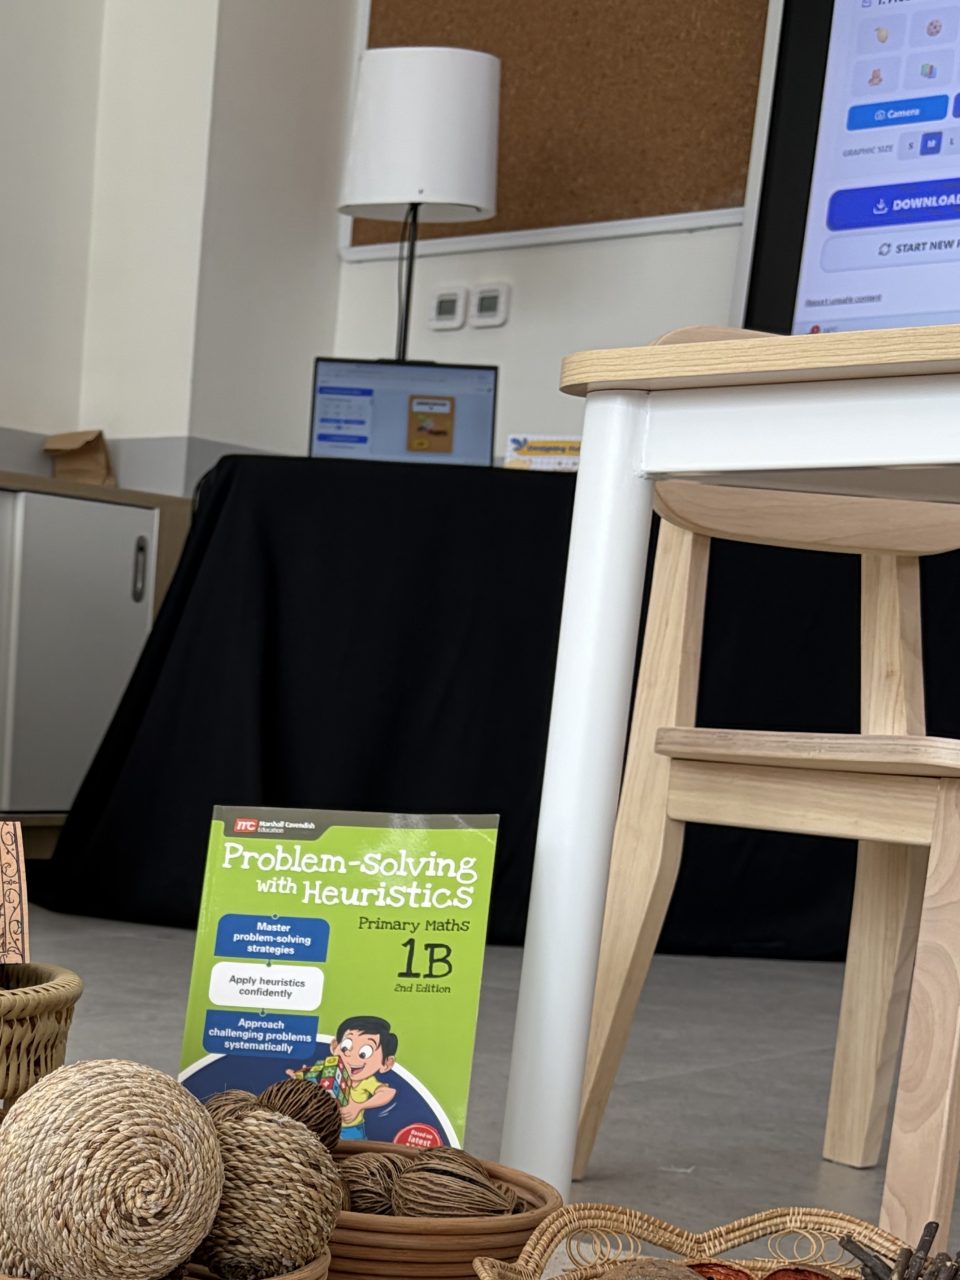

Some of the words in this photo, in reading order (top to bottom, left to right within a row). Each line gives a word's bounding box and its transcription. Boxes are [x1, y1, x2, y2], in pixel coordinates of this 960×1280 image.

[887, 108, 920, 119] Camera
[877, 144, 894, 153] SIZE
[908, 142, 915, 150] S
[927, 140, 937, 149] M
[895, 241, 928, 255] START
[929, 239, 956, 251] NEW
[285, 821, 316, 829] Cavendish
[256, 877, 298, 895] with
[302, 880, 475, 910] Heuristics
[256, 922, 291, 932] Master
[358, 916, 421, 934] Primary
[425, 918, 471, 932] Maths
[233, 932, 312, 947] problem-solving
[247, 944, 295, 956] strategies
[397, 937, 453, 979] 1B
[229, 975, 257, 986] Apply
[259, 976, 306, 988] heuristics
[238, 987, 293, 1000] confidently
[394, 983, 413, 993] 2nd
[415, 983, 452, 994] Edition
[237, 1018, 285, 1030] Approach
[208, 1028, 264, 1041] challenging
[265, 1030, 312, 1042] problems
[224, 1040, 294, 1054] systematically
[407, 1134, 432, 1148] latest
